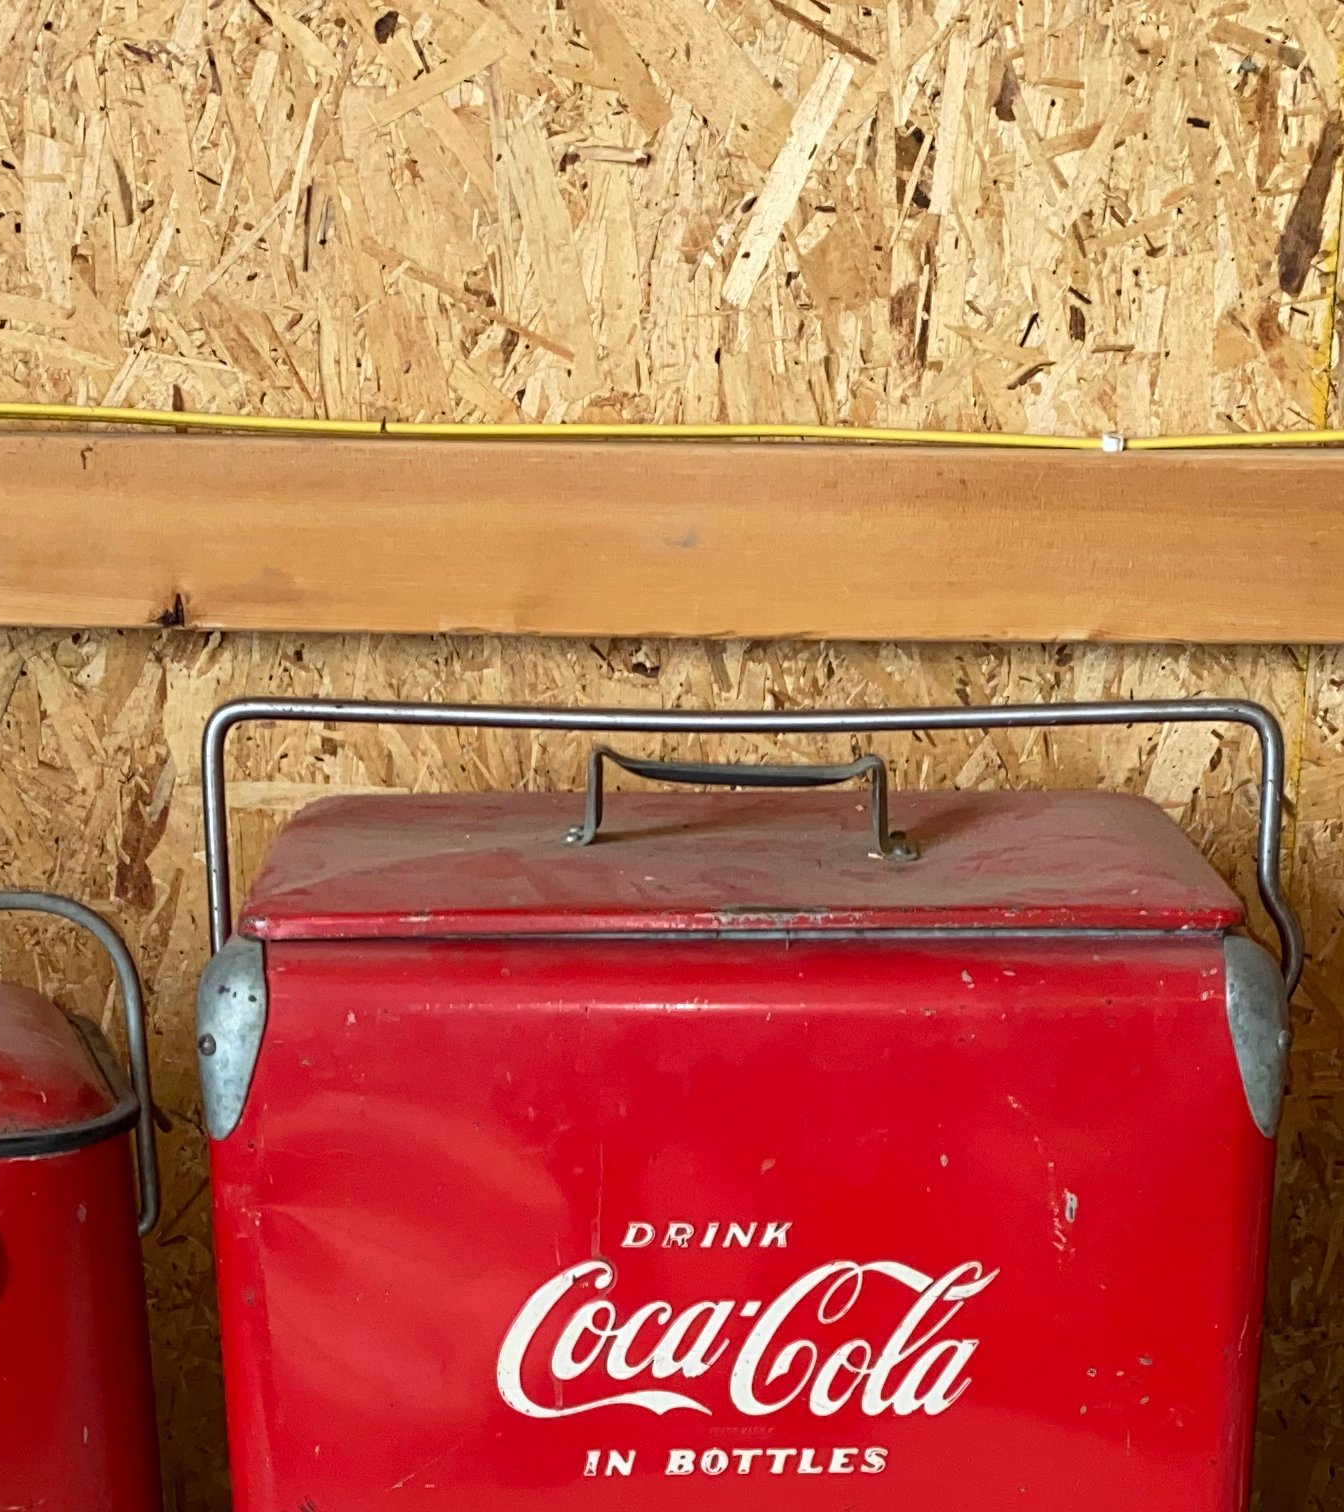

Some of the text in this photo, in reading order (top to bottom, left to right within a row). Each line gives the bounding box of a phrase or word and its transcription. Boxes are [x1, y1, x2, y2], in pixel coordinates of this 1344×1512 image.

[621, 1221, 793, 1248] DRINK
[496, 1259, 1001, 1418] Coca-Cola
[584, 1447, 889, 1477] IN BOTTLES
